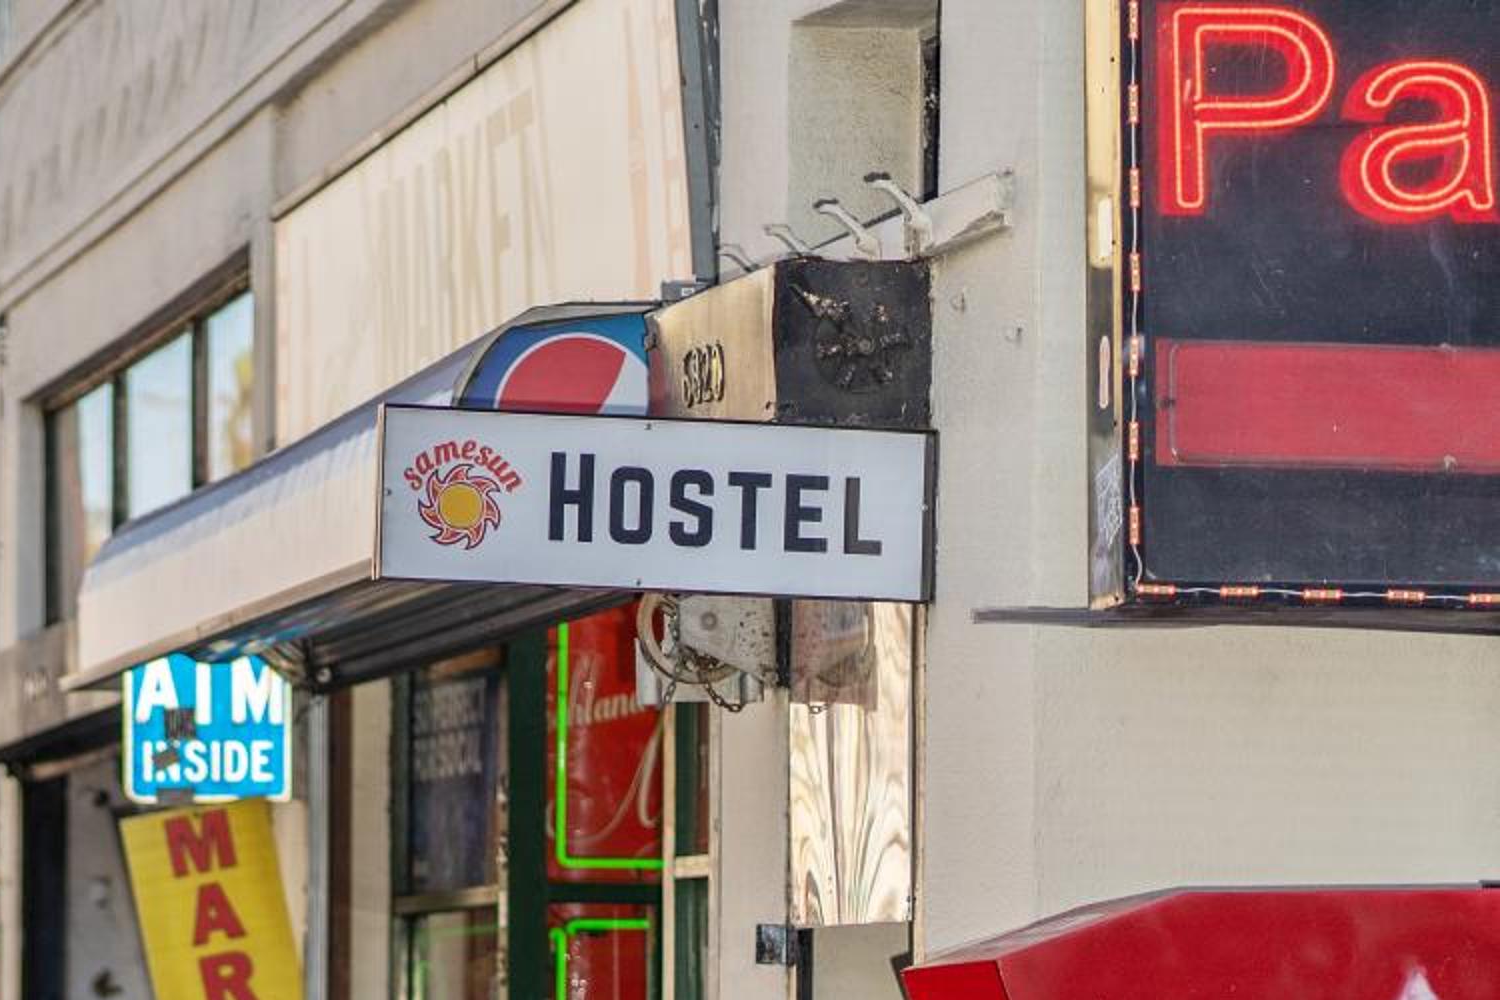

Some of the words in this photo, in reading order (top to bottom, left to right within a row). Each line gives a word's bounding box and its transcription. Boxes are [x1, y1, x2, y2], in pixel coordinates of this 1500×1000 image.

[1156, 3, 1500, 224] Pa
[403, 438, 524, 494] samesun
[547, 451, 883, 556] HOSTEL
[141, 739, 276, 784] INSIDE
